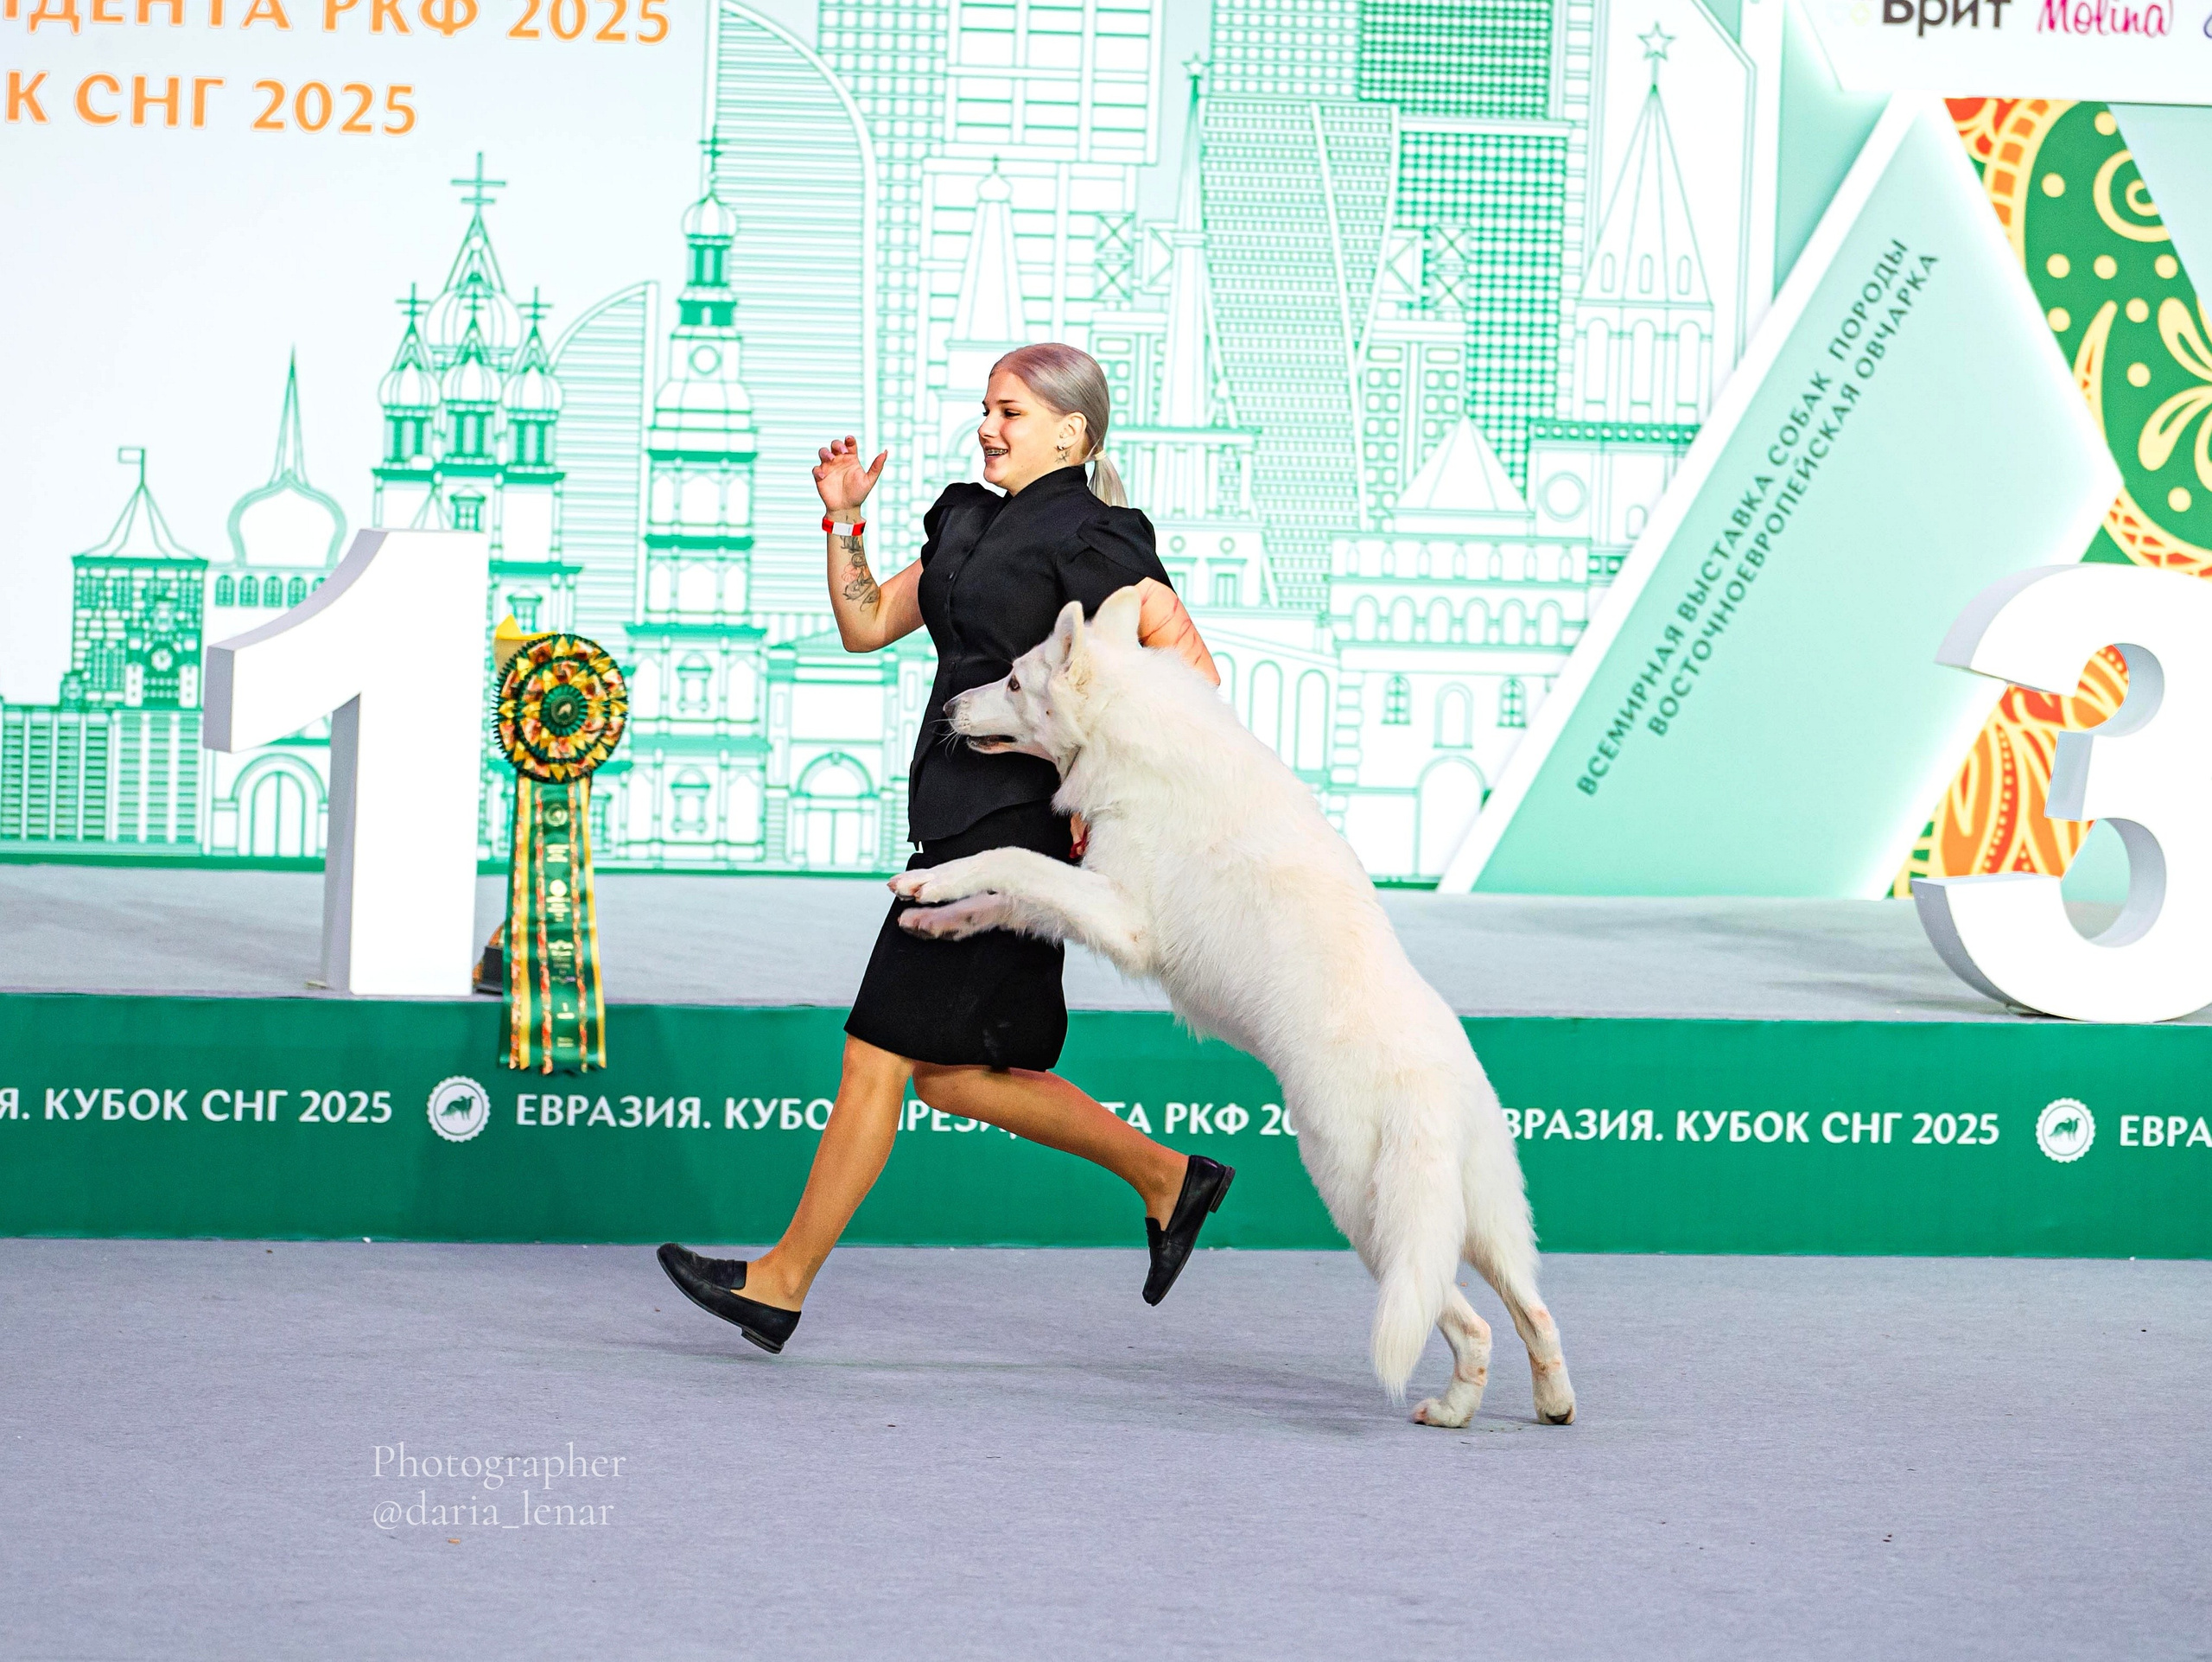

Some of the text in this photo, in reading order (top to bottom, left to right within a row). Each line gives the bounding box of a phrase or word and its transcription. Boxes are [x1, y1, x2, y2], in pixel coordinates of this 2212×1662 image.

[321, 0, 480, 40] РКФ
[506, 0, 671, 45] 2025
[2037, 0, 2175, 39] Molina
[5, 69, 418, 137] К СНГ 2025
[1647, 254, 1940, 737] ВОСТОЧНОЕВРОПЕЙСКАЯ ОВЧАРКА
[1576, 239, 1909, 797] ВСЕМИРНАЯ ВЫСТАВКА СОБАК ПОРОДЫ
[44, 1089, 188, 1122] КУБОК
[201, 1089, 289, 1122] СНГ
[298, 1091, 393, 1123] 2025
[517, 1094, 712, 1129] ЕВРАЗИЯ.
[724, 1098, 835, 1130] КУБО
[1165, 1101, 1250, 1135] РКФ
[1502, 1107, 2000, 1145] ВРАЗИЯ. КУБОК СНГ 2025
[2119, 1115, 2212, 1148] ЕВРА
